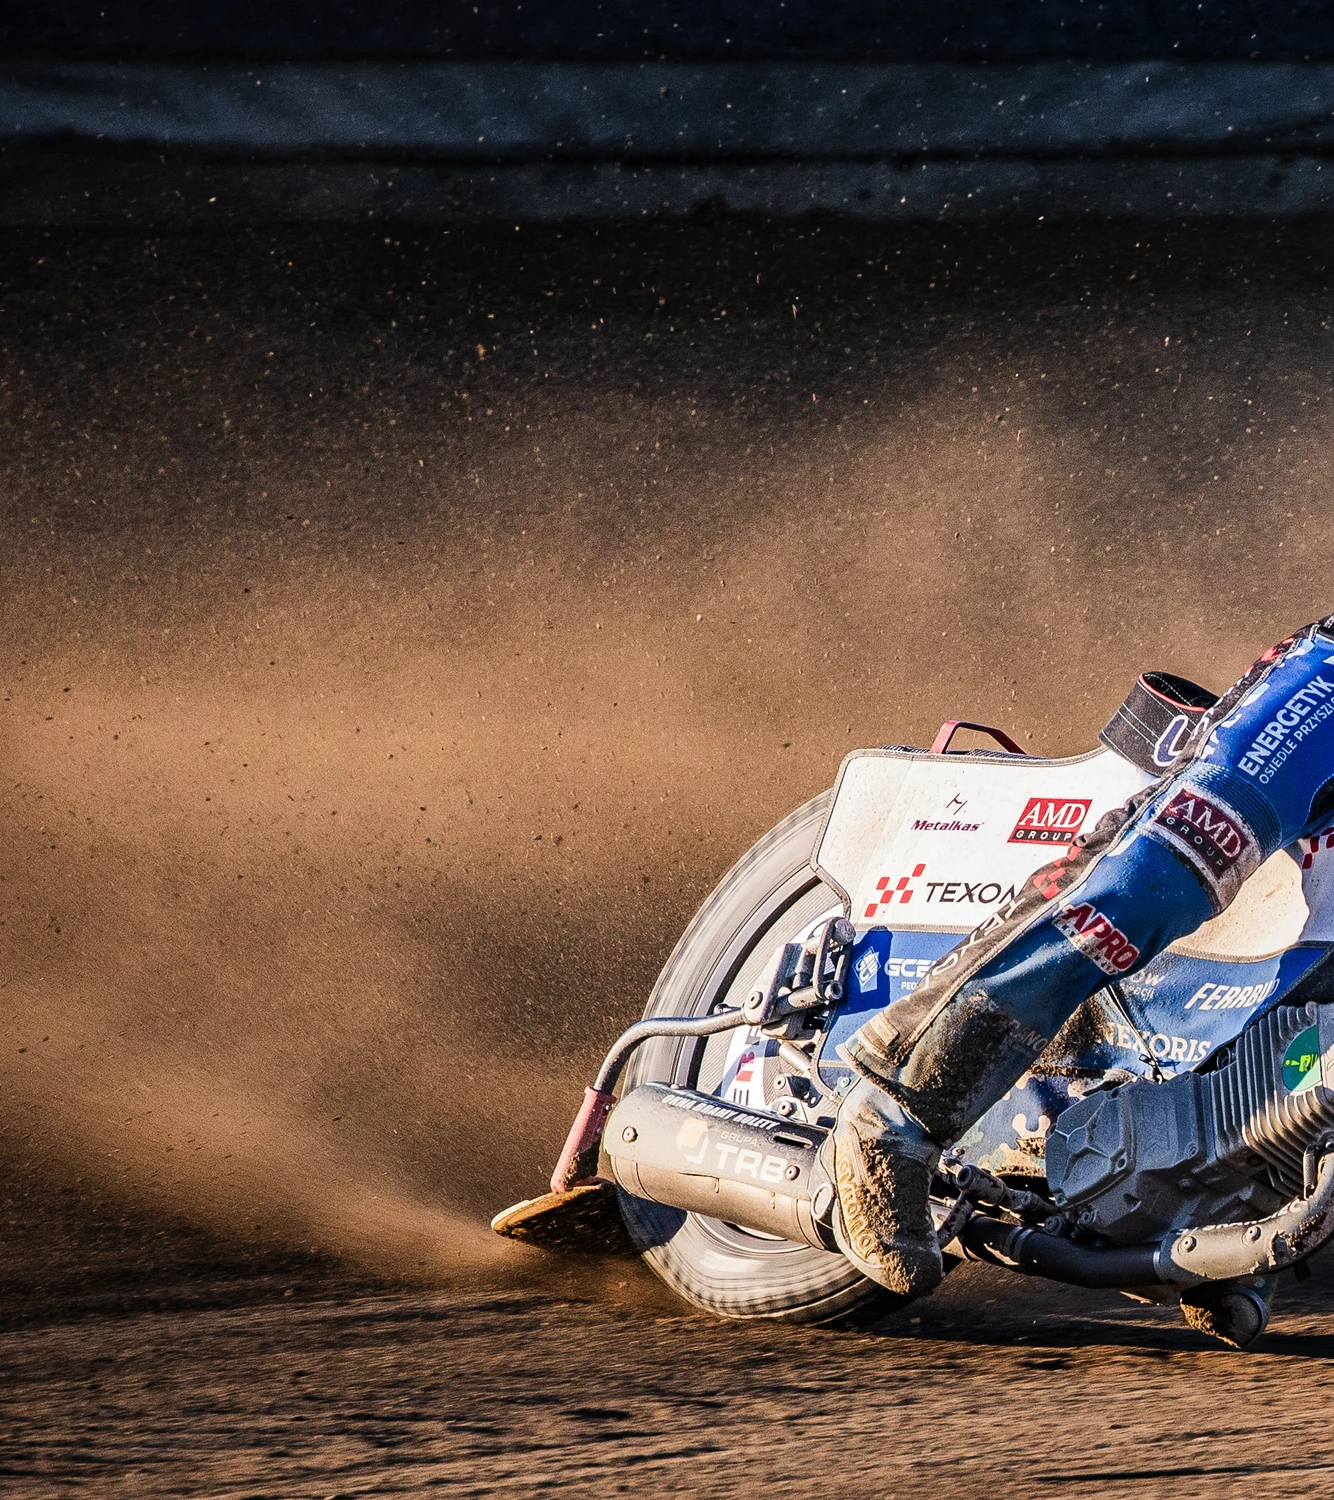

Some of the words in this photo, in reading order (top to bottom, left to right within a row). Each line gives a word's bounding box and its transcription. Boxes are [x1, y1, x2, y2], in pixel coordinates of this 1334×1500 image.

[1259, 739, 1298, 784] OSIEDLE
[910, 820, 980, 832] Metalkas
[1018, 803, 1086, 828] AMD
[1169, 798, 1242, 859] AMD
[1015, 830, 1076, 841] GROUP
[1165, 817, 1224, 867] GROUP
[1060, 903, 1140, 971] APRO
[884, 957, 935, 978] GCE
[720, 1130, 759, 1147] GRUPA
[715, 1142, 789, 1184] TRB
